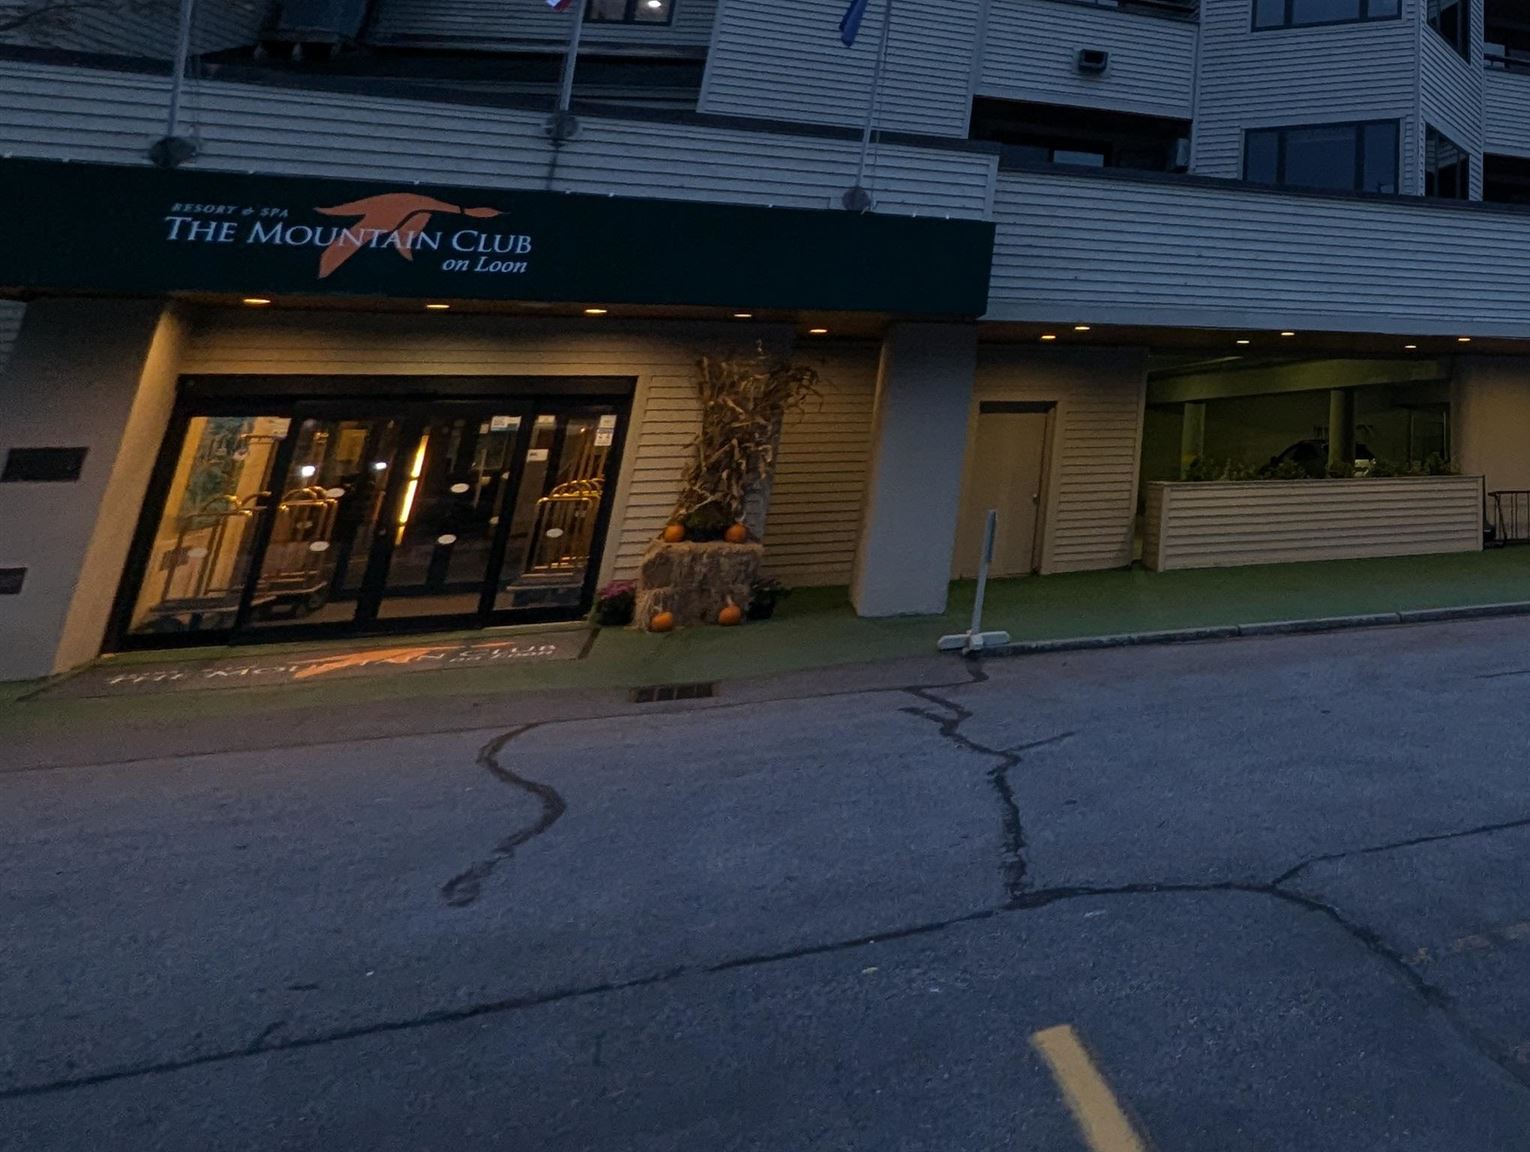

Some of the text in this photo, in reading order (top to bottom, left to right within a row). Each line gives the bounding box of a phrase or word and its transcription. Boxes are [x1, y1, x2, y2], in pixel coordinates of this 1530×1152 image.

[171, 202, 236, 215] RESORT
[260, 207, 289, 218] SPA
[164, 216, 533, 255] THE MOUNTAIN CLUB
[442, 256, 528, 274] on Loon
